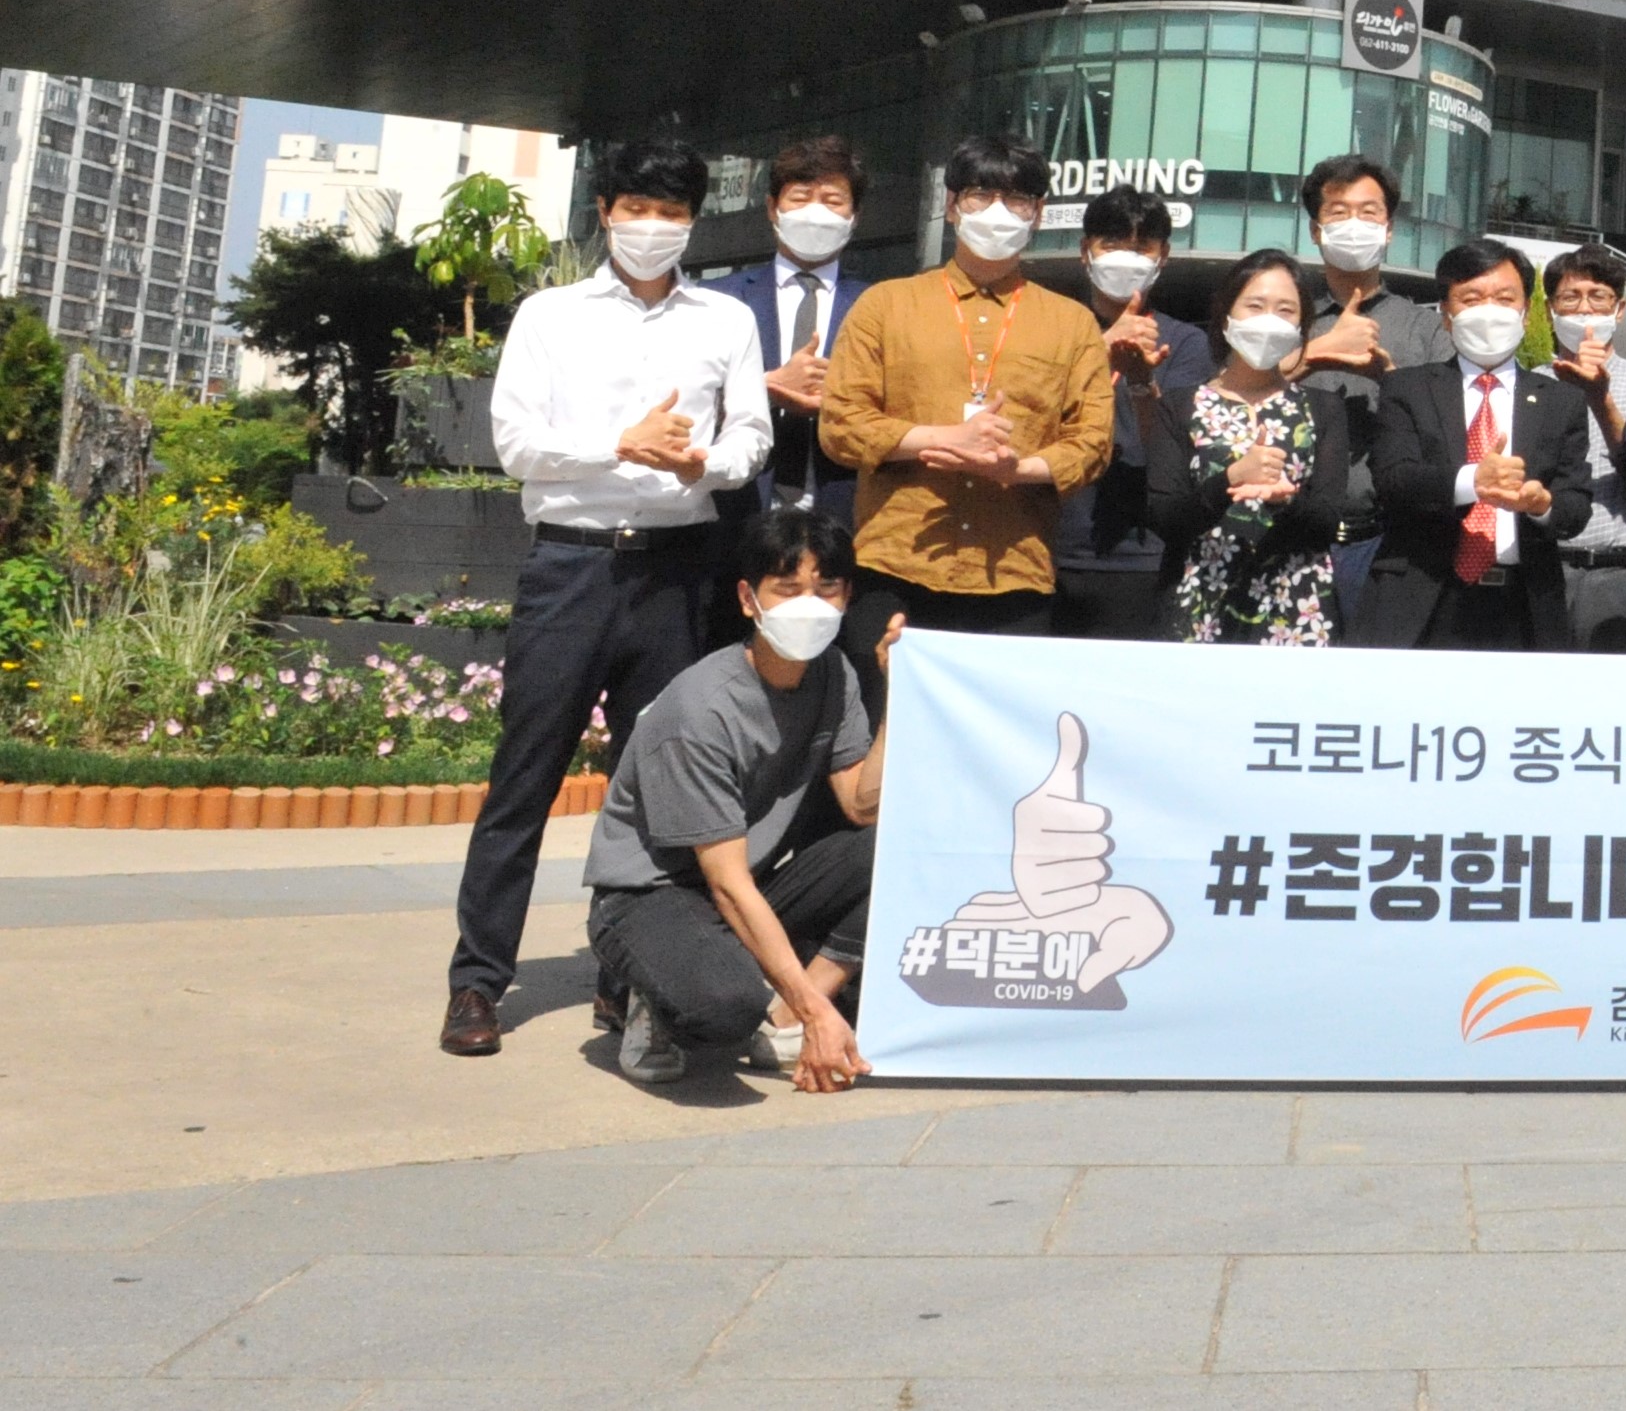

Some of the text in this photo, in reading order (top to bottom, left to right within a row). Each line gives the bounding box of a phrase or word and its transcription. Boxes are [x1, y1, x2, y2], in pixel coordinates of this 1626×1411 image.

[1047, 158, 1205, 196] RDENING
[1247, 722, 1486, 782] 코로나19
[900, 927, 1091, 981] #덕분에
[993, 983, 1074, 1001] COVID-19
